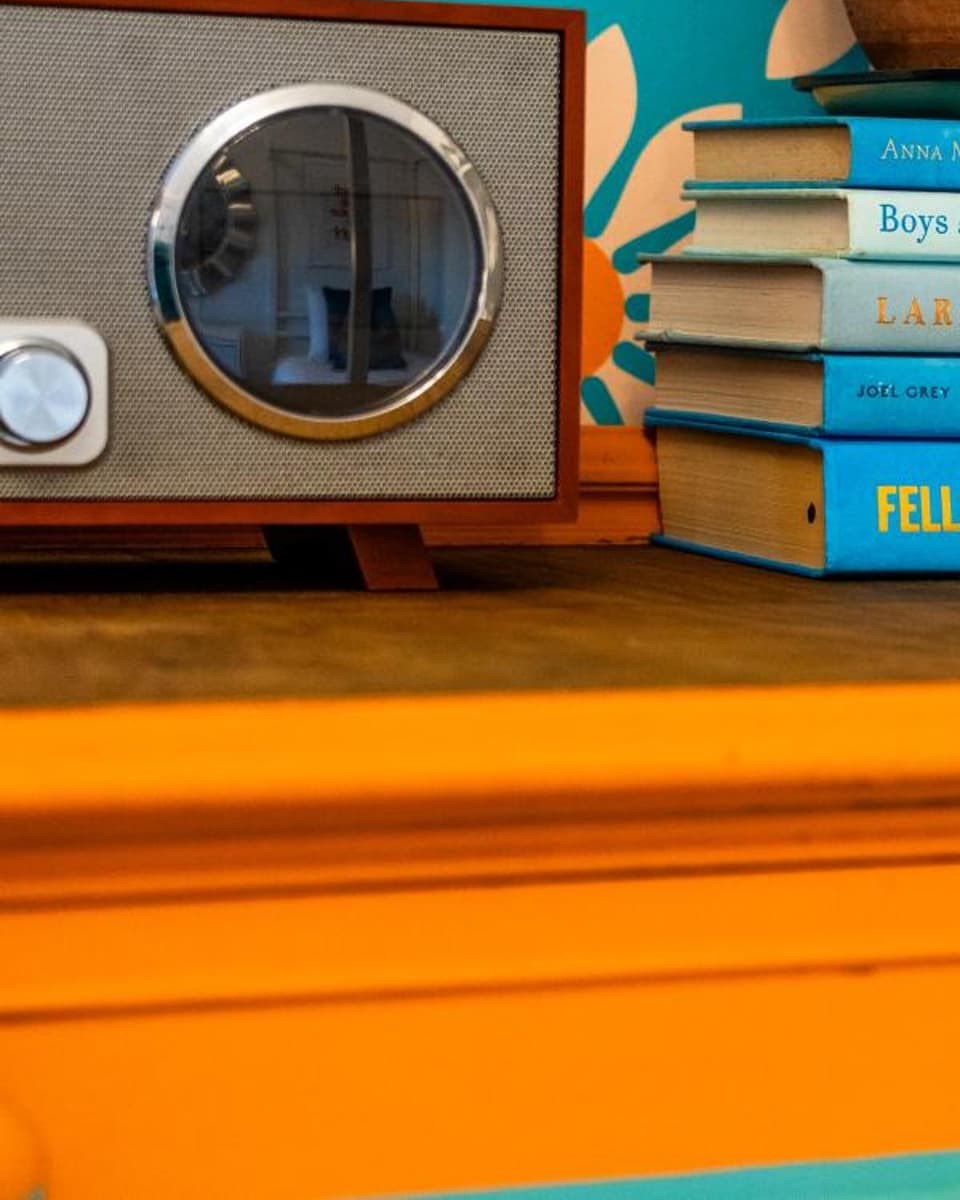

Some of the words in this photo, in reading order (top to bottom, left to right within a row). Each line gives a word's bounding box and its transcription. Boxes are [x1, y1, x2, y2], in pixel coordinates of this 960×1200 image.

[879, 203, 949, 243] Boys
[856, 384, 898, 399] JOEL
[906, 386, 950, 400] GREY
